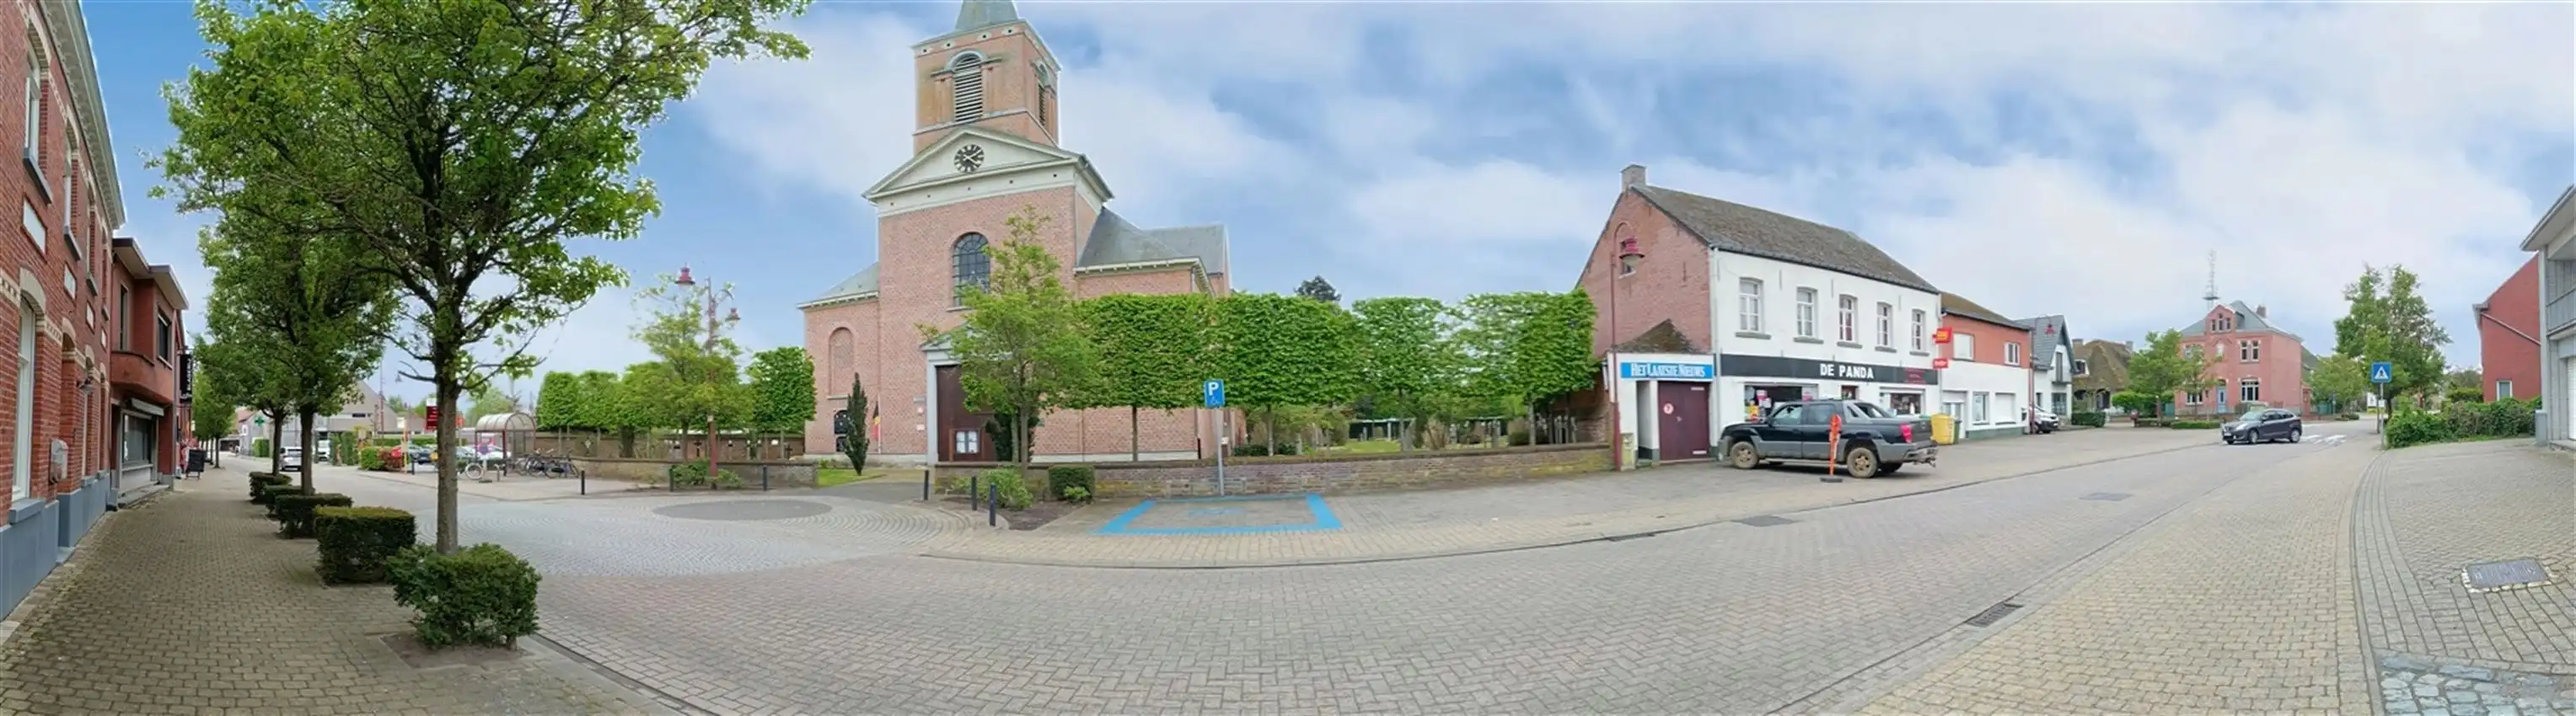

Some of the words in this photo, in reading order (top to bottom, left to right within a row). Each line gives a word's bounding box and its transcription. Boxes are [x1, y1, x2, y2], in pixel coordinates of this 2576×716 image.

[1820, 363, 1834, 377] DE
[1838, 365, 1874, 379] PANDA
[1208, 382, 1219, 396] P
